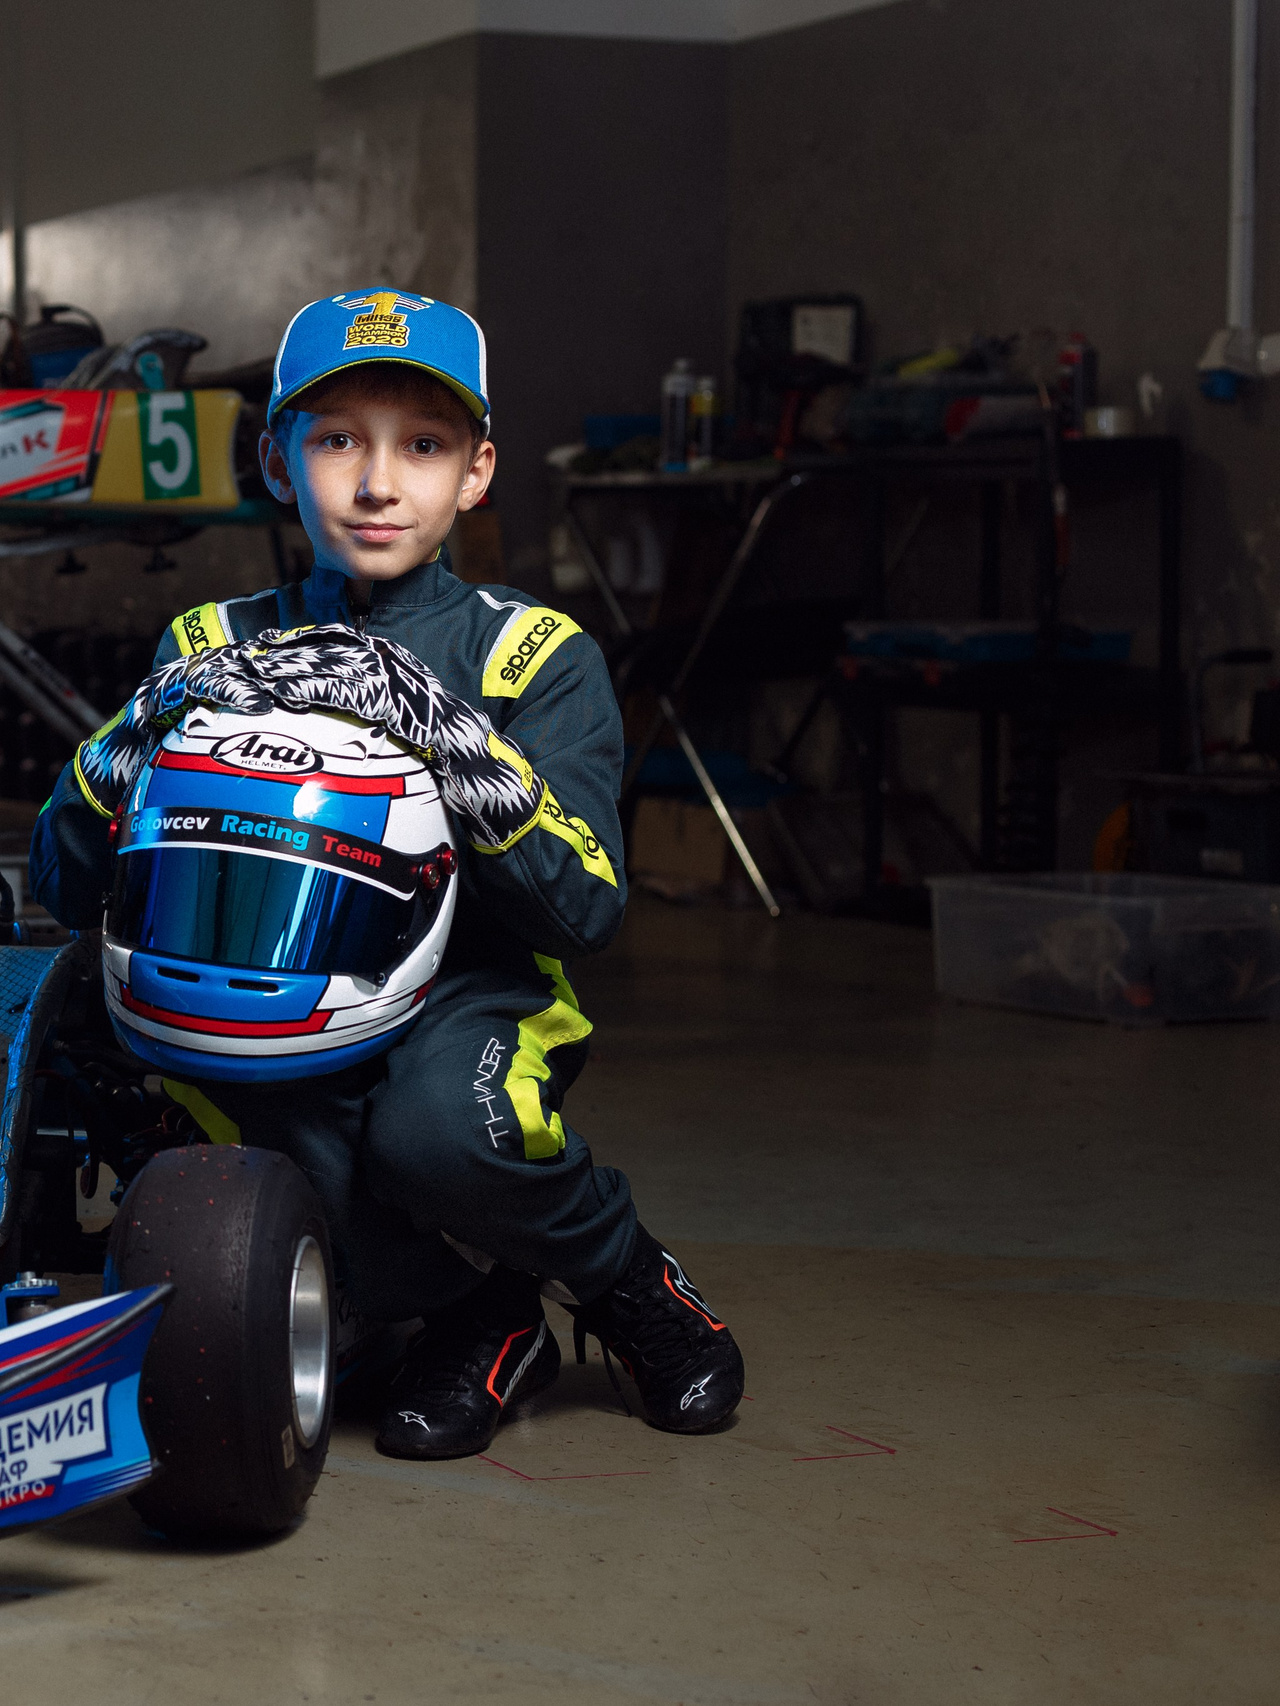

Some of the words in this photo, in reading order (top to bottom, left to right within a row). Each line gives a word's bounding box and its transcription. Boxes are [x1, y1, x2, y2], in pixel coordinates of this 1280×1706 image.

[346, 335, 406, 347] 2020
[348, 323, 406, 333] WORLD
[348, 330, 405, 339] CHAMPION
[148, 391, 193, 490] 5
[500, 616, 562, 685] sparco
[214, 734, 312, 766] Arai
[220, 814, 310, 851] Racing
[322, 834, 382, 868] Team
